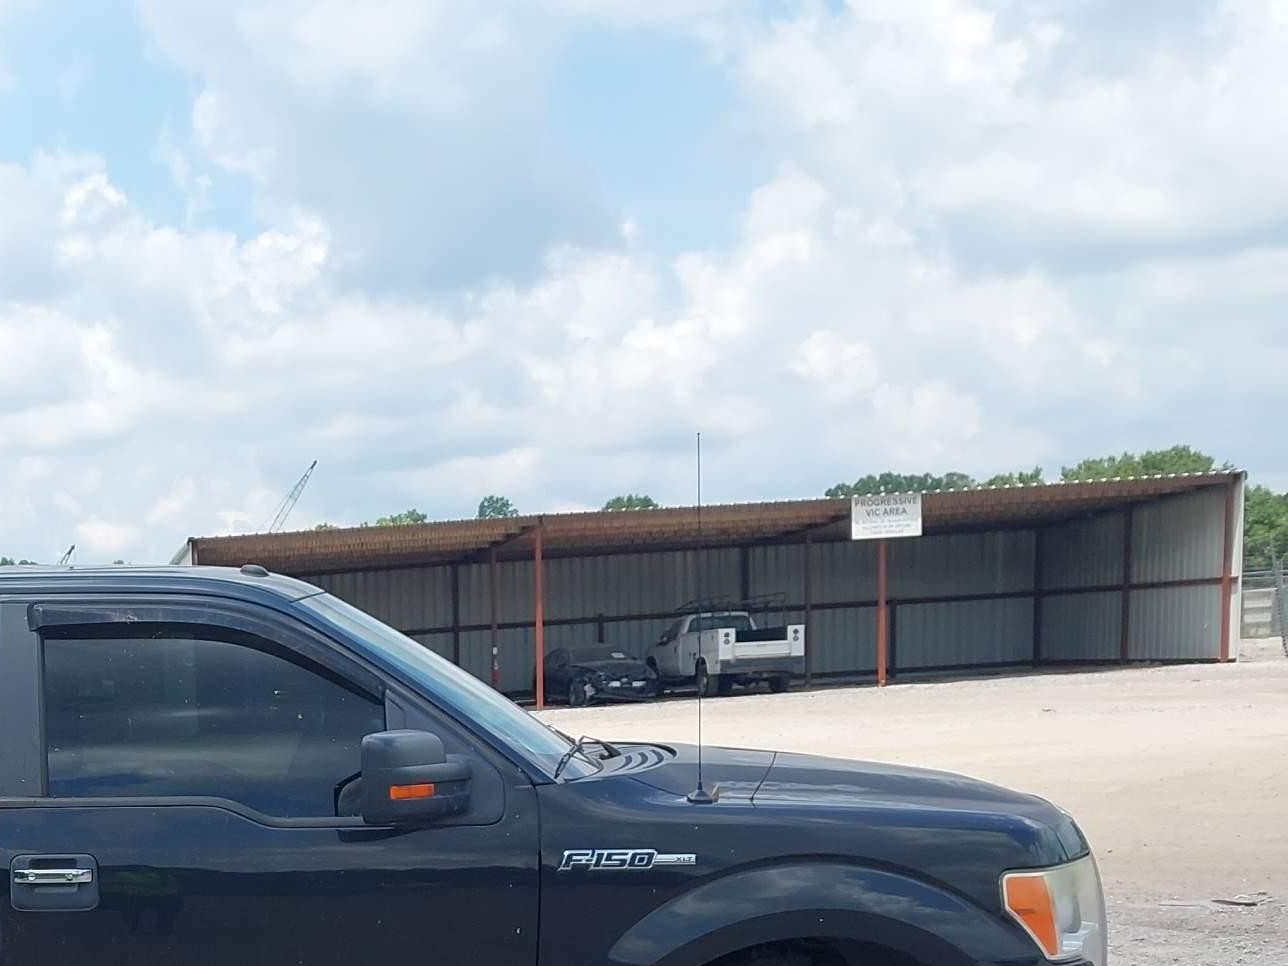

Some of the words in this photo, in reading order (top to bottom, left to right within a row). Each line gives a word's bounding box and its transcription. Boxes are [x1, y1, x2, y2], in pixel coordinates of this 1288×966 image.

[855, 496, 918, 507] PROGRESSIVE
[865, 508, 881, 516] VIC
[883, 507, 907, 516] AREA
[558, 849, 657, 871] F-150
